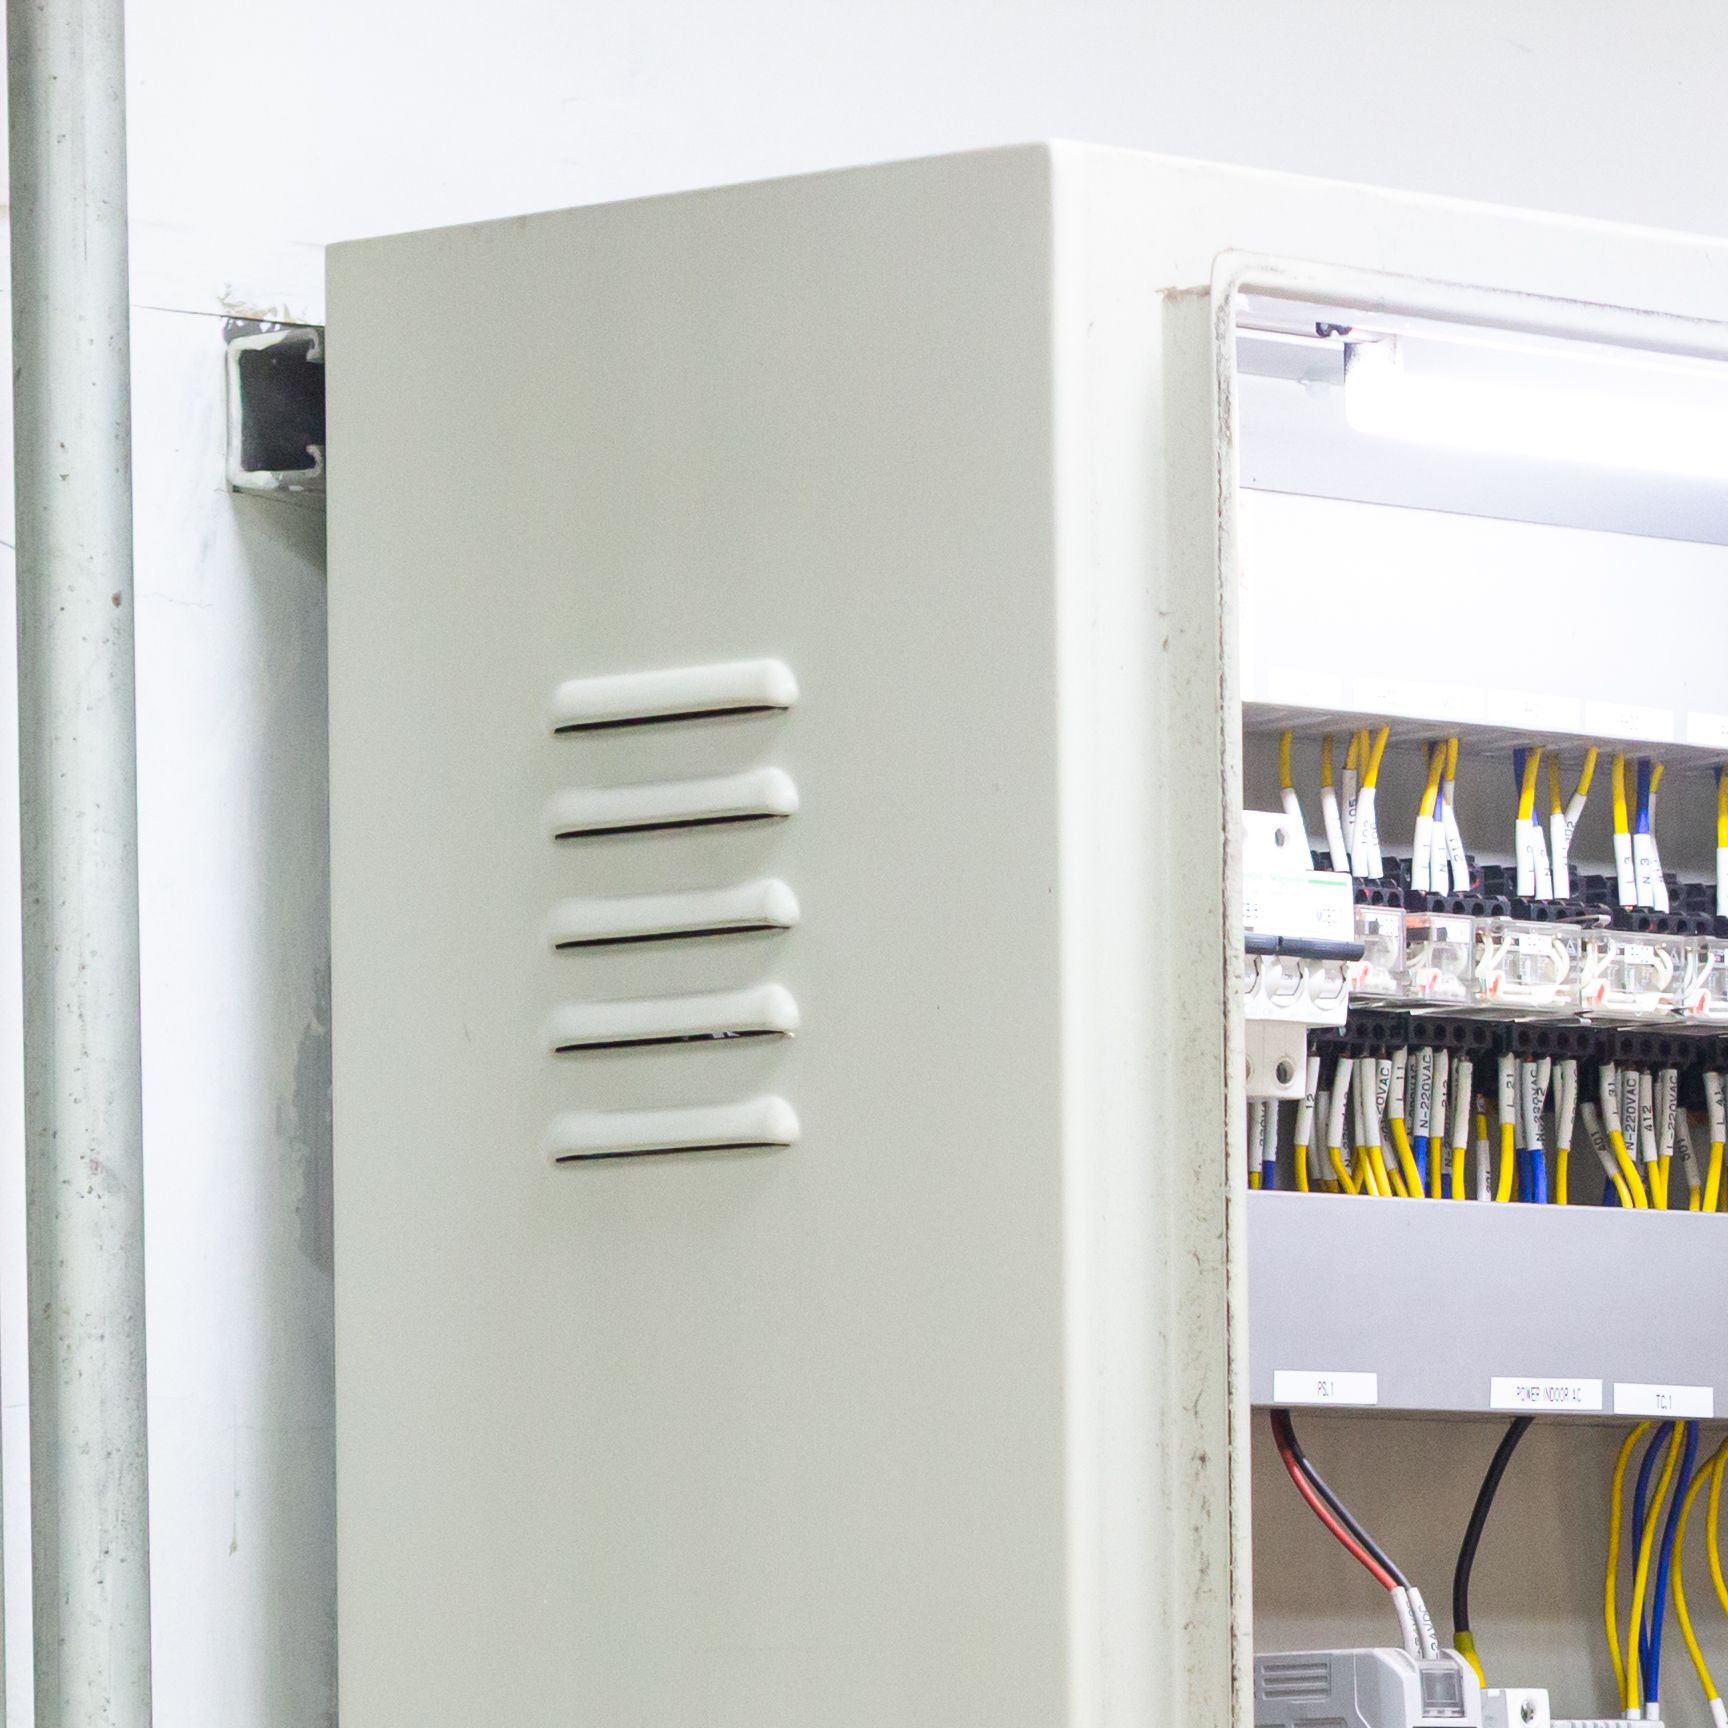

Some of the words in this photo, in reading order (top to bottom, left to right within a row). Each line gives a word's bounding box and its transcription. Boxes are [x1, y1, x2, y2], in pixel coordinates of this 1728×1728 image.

[1640, 858, 1650, 866] 3
[1643, 876, 1652, 885] N
[1420, 1053, 1432, 1129] N-220VAC
[1625, 1078, 1638, 1151] N-220VAC
[1642, 1105, 1652, 1132] 412
[1516, 1386, 1540, 1402] POWER
[1543, 1386, 1568, 1402] INDOOR
[1572, 1387, 1582, 1403] AC
